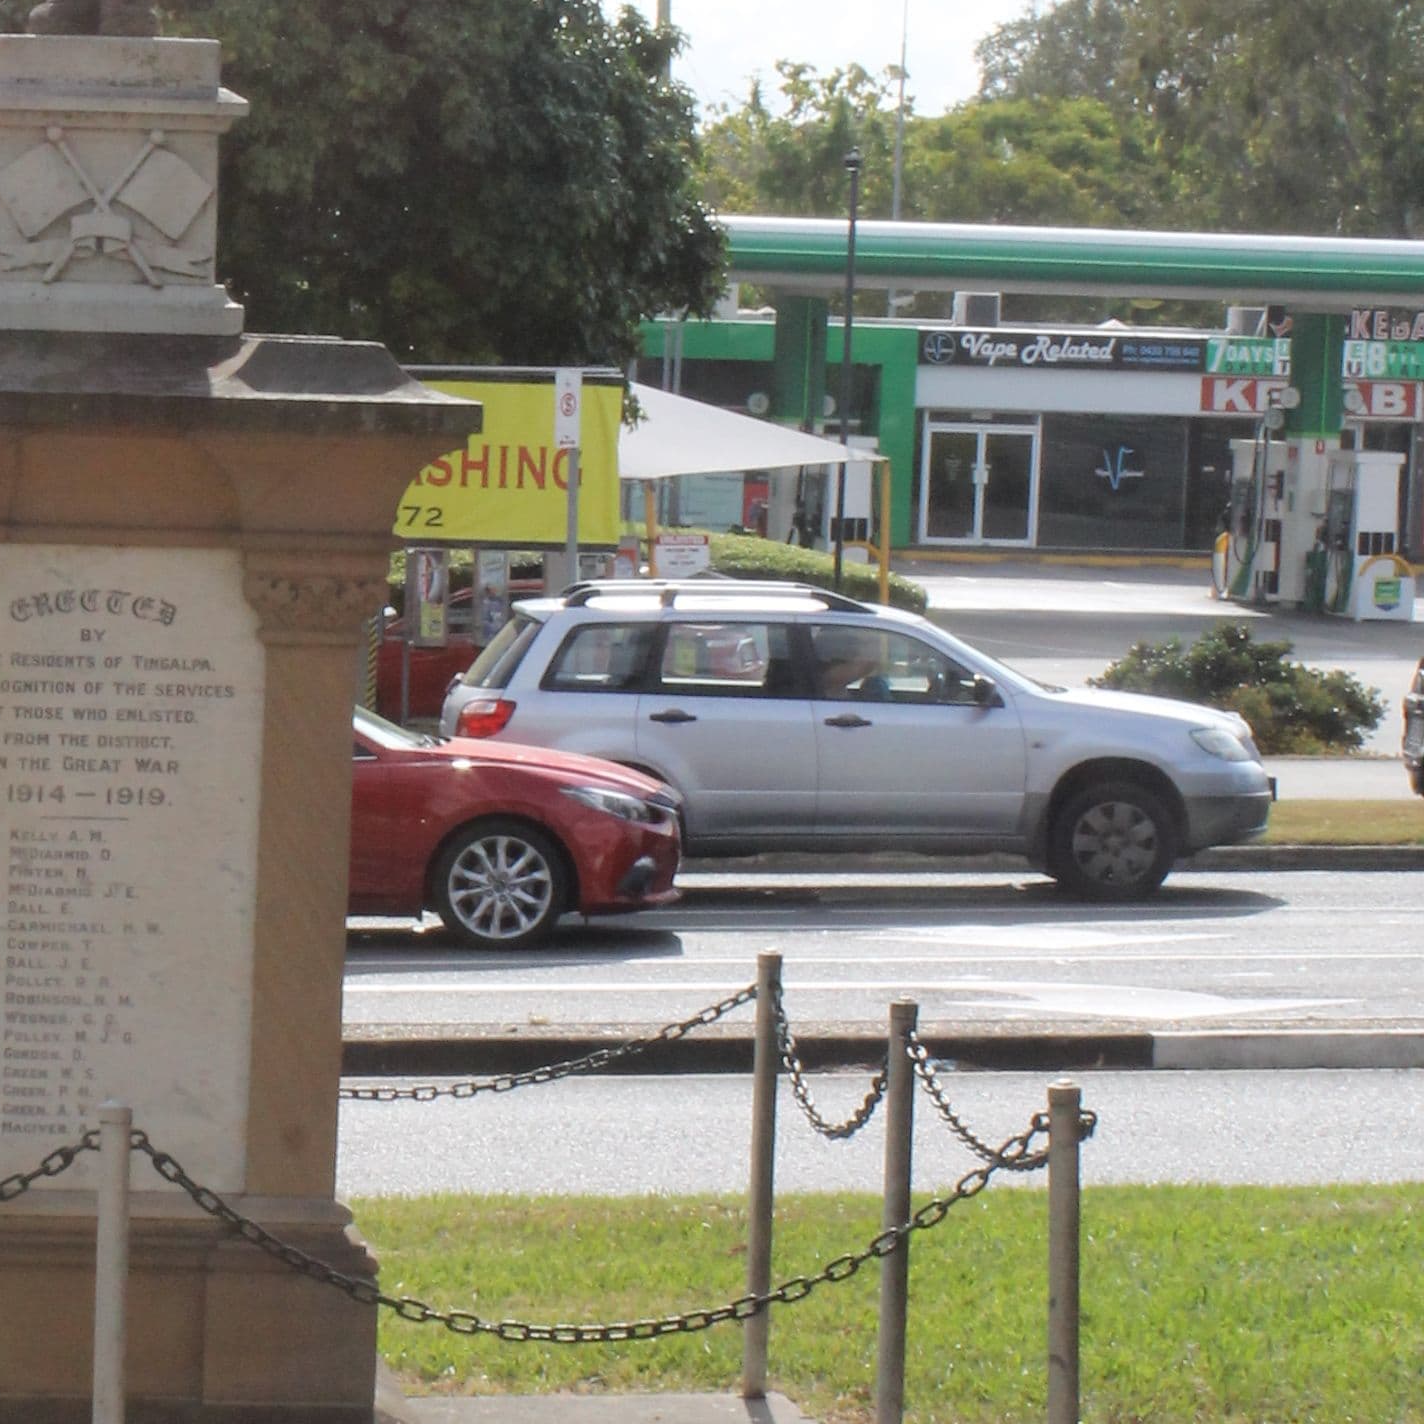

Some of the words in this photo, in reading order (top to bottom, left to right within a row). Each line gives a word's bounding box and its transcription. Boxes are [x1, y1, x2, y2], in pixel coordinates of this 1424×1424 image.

[960, 332, 1018, 366] Vape
[1020, 334, 1116, 364] Related
[1228, 344, 1274, 364] DAYS
[9, 589, 177, 627] ERECTED
[80, 628, 106, 643] BY
[10, 652, 96, 669] RESIDENTS
[104, 656, 123, 670] OF
[83, 680, 105, 695] OF
[112, 680, 146, 696] THE
[154, 682, 236, 698] SERVICES
[13, 706, 64, 721] THOSE
[72, 708, 108, 722] WHO
[2, 732, 50, 746] FROM
[58, 733, 89, 748] THE
[18, 756, 52, 772] THE
[62, 756, 123, 774] GREAT
[134, 758, 181, 776] WAR
[7, 783, 66, 805] 1914
[9, 829, 59, 843] KELLY
